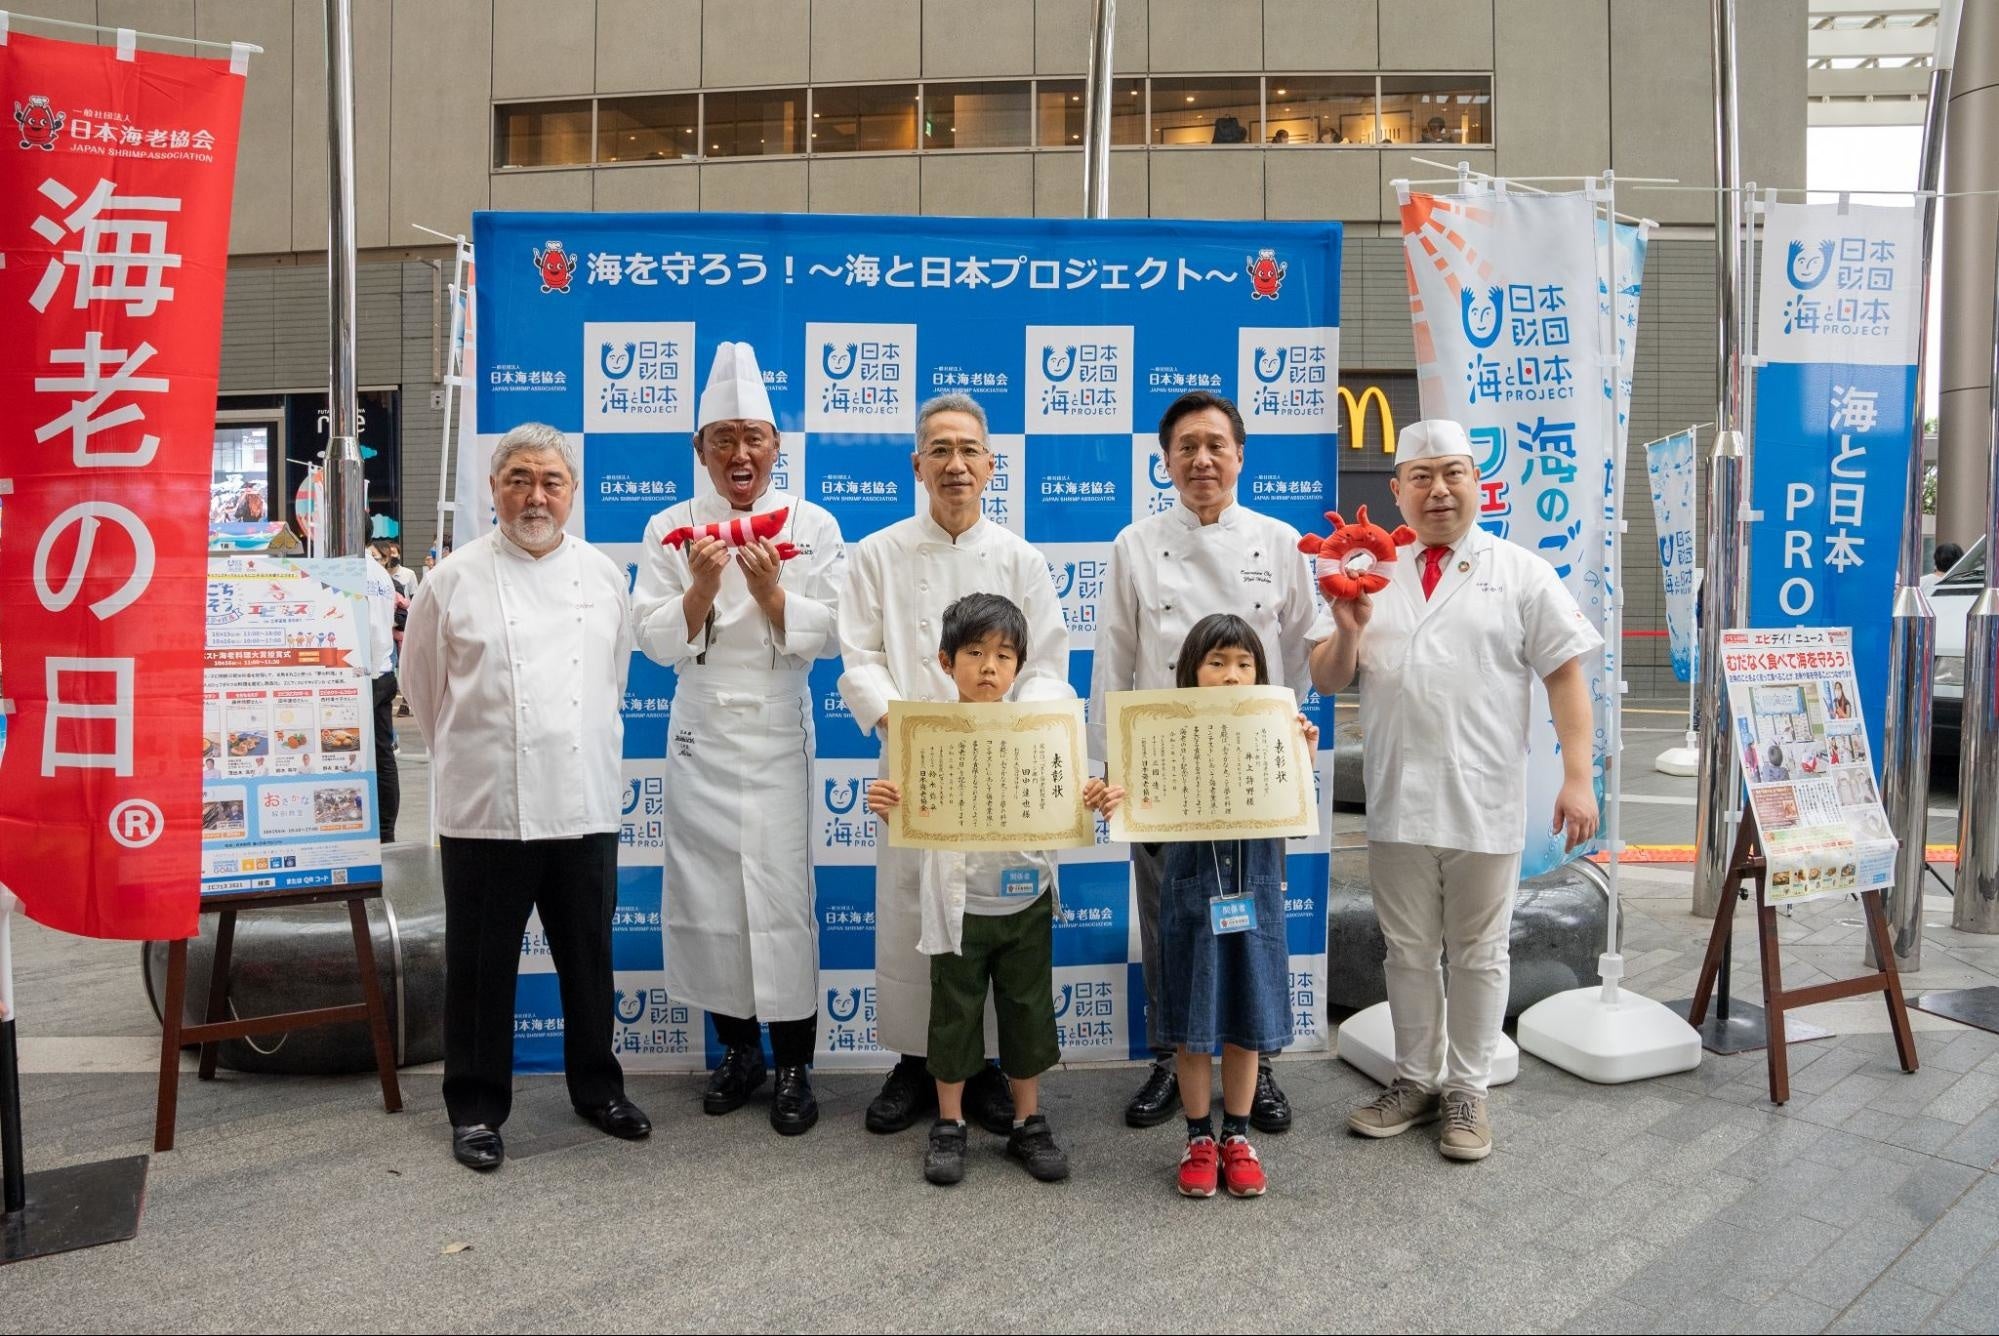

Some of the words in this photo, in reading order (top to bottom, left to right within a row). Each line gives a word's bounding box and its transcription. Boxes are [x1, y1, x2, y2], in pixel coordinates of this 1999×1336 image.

[73, 108, 133, 122] 一般社団法人
[71, 120, 216, 151] 日本海老協会
[70, 143, 105, 154] JAPAN
[108, 147, 147, 159] SHRIMP
[147, 152, 213, 163] ASSOCIATION
[1839, 237, 1895, 264] 日本
[1838, 266, 1894, 291] 財団
[1509, 284, 1566, 312] 日本
[1512, 316, 1570, 347] 財団
[1822, 323, 1890, 336] PROJECT
[640, 341, 678, 359] 日本
[861, 343, 900, 360] 日本
[1080, 345, 1117, 362] 日本
[1290, 346, 1326, 363] 日本
[490, 371, 567, 384] 日本海老協会
[639, 362, 678, 380] 財団
[861, 363, 900, 381] 財団
[1080, 365, 1117, 382] 財団
[1290, 366, 1325, 383] 財団
[933, 373, 1008, 386] 日本海老協会
[1149, 373, 1222, 386] 日本海老協会
[1506, 386, 1574, 402] PROJECT
[631, 405, 678, 414] PROJECT
[852, 406, 899, 414] PROJECT
[1071, 408, 1117, 416] PROJECT
[1281, 408, 1325, 416] PROJECT
[1253, 480, 1323, 493] 日本海老協会
[1824, 384, 1879, 574] 海と日本
[600, 481, 677, 494] 日本海老協会
[822, 481, 898, 494] 日本海老協会
[1041, 482, 1116, 495] 日本海老協会
[1274, 739, 1288, 783] 表彰状
[1051, 753, 1063, 798] 表彰状
[1076, 982, 1112, 998] 日本
[650, 1008, 688, 1024] 財団
[1076, 1000, 1112, 1017] 財団
[643, 1046, 688, 1054] PROJECT
[1069, 1038, 1113, 1046] PROJECT
